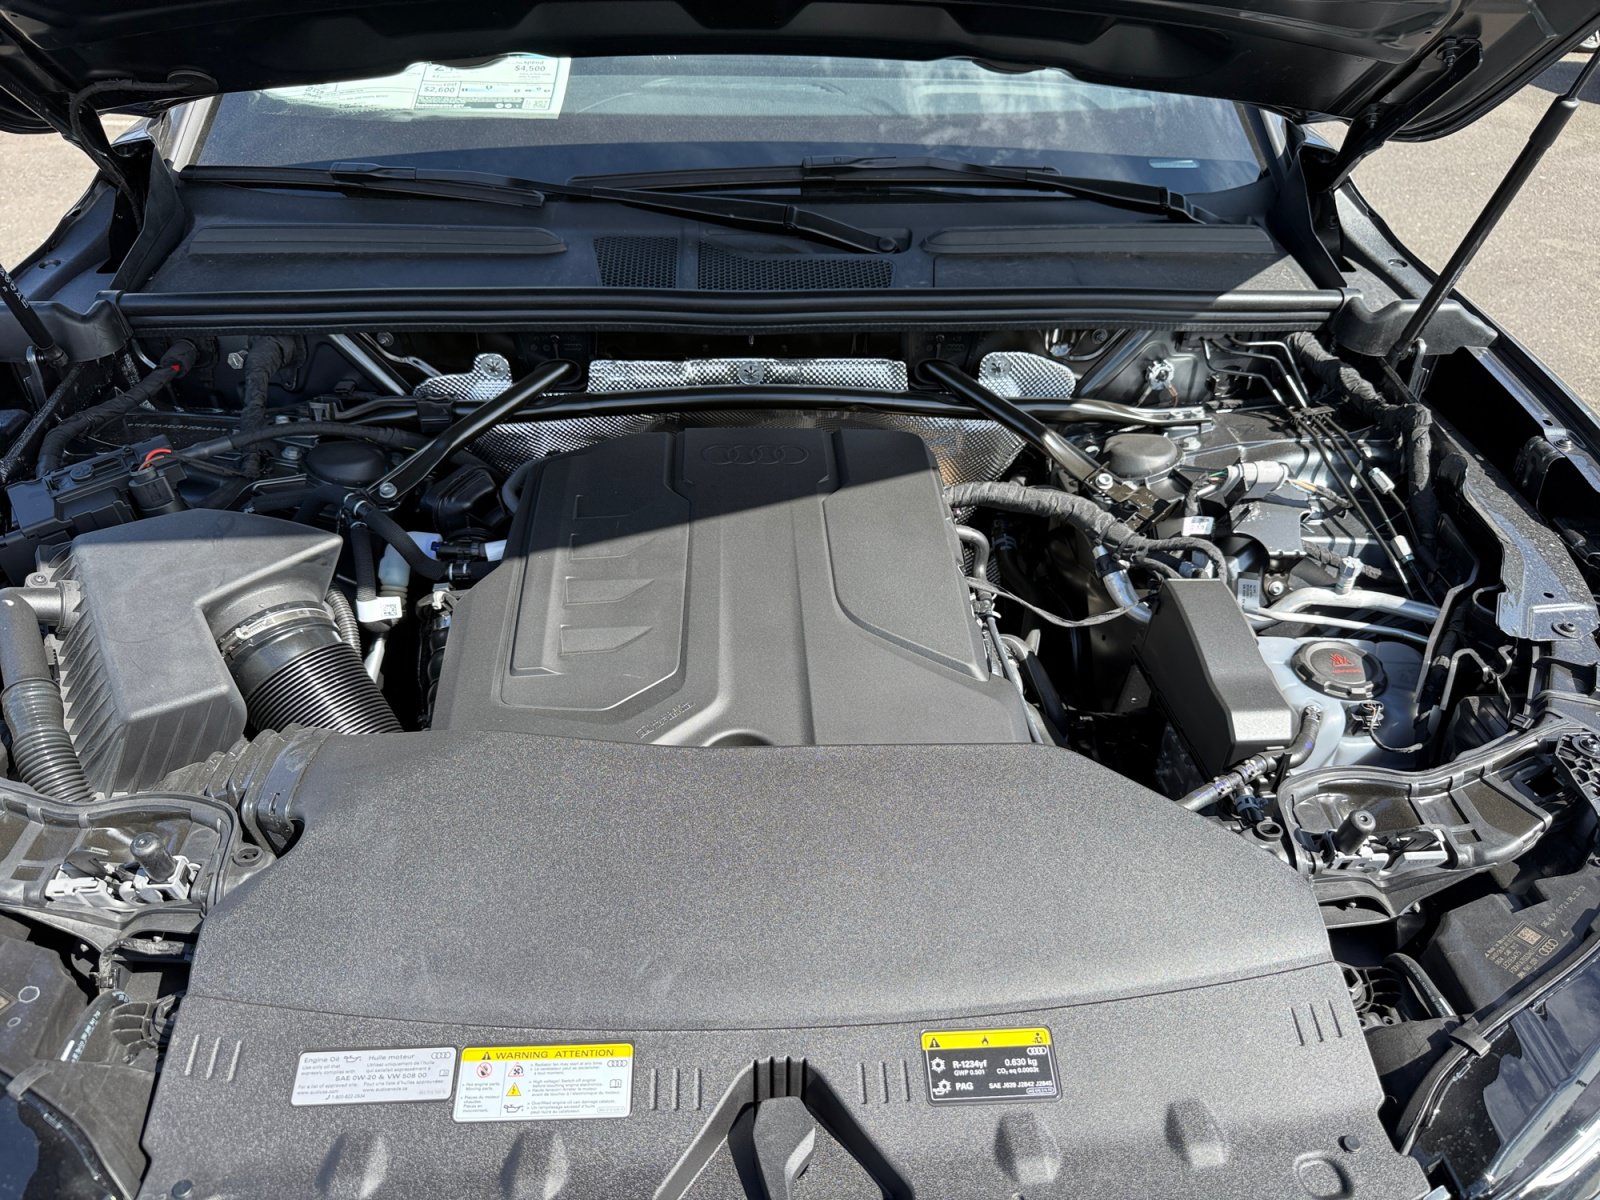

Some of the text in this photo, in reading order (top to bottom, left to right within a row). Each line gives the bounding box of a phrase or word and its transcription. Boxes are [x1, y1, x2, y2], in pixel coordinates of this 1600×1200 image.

[496, 1049, 613, 1059] WARNING ATTENTION
[952, 1060, 987, 1069] R-1234yf
[1028, 1058, 1038, 1066] kg
[955, 1082, 973, 1091] PAG
